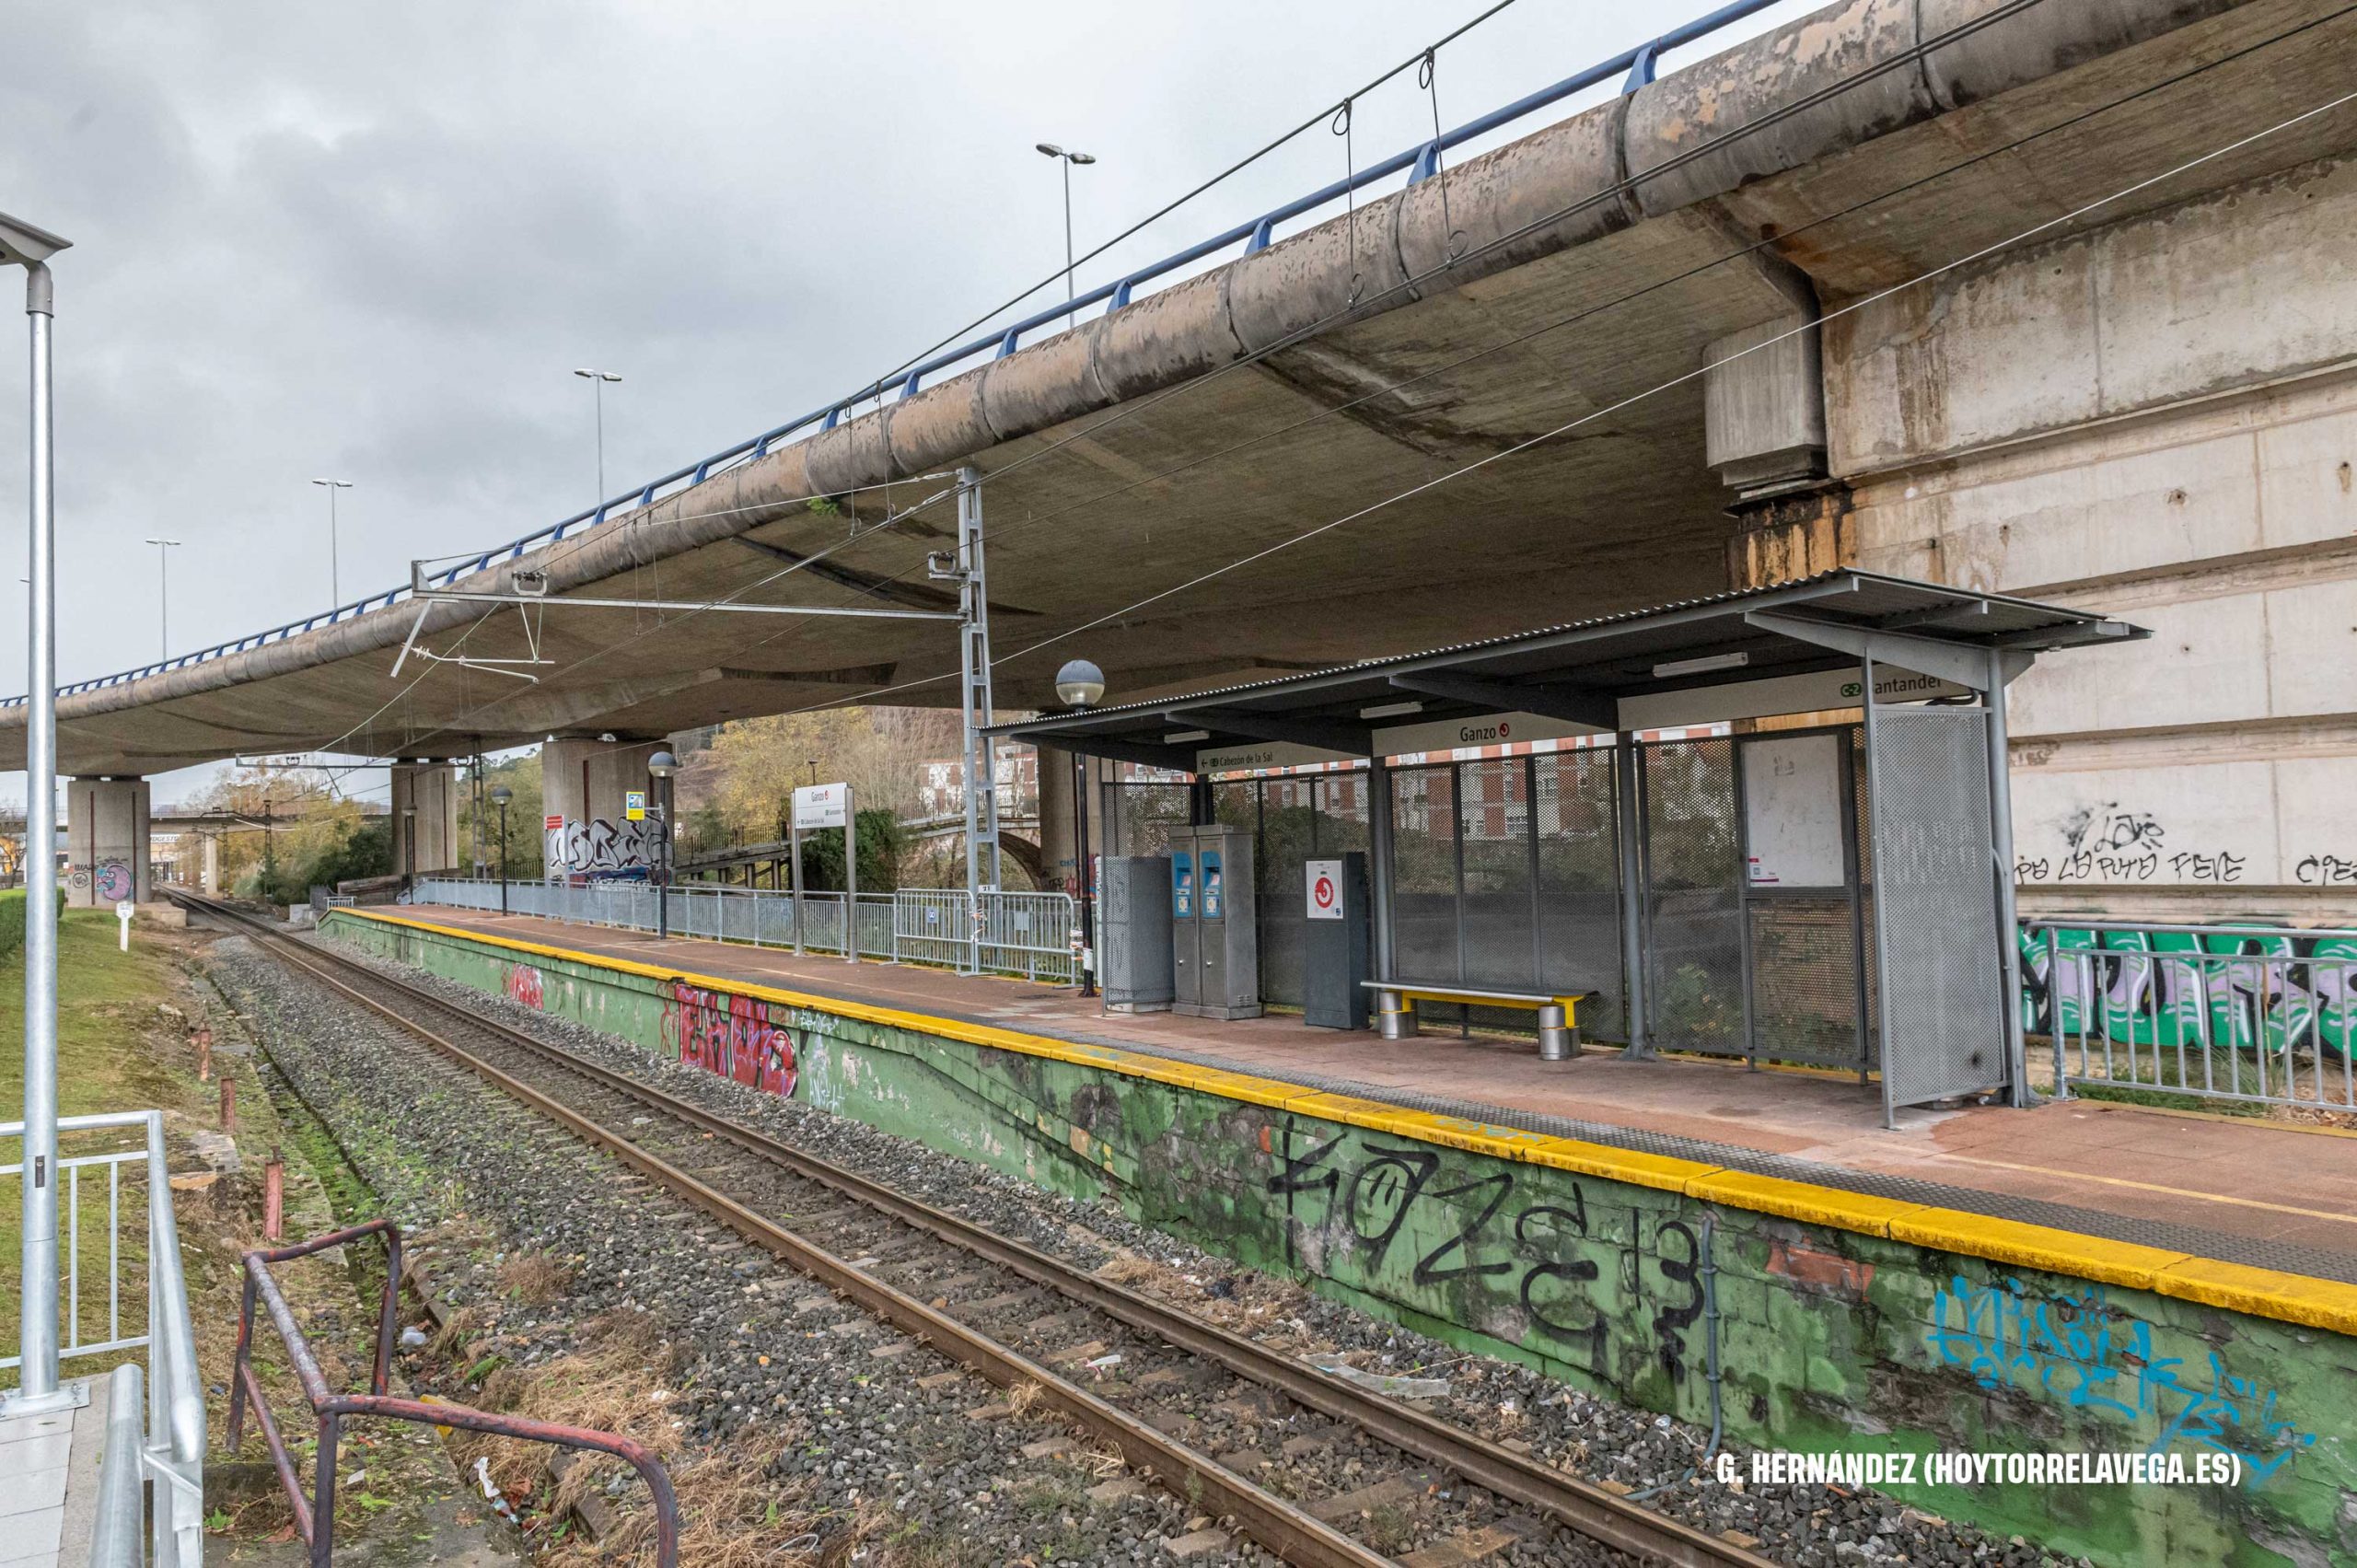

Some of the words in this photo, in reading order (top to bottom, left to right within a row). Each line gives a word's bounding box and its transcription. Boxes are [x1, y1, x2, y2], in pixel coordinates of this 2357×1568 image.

[1842, 684, 1860, 695] C-2
[1460, 726, 1496, 741] Ganzo
[1246, 754, 1254, 763] de
[1255, 753, 1261, 762] la
[1262, 751, 1273, 761] Sal
